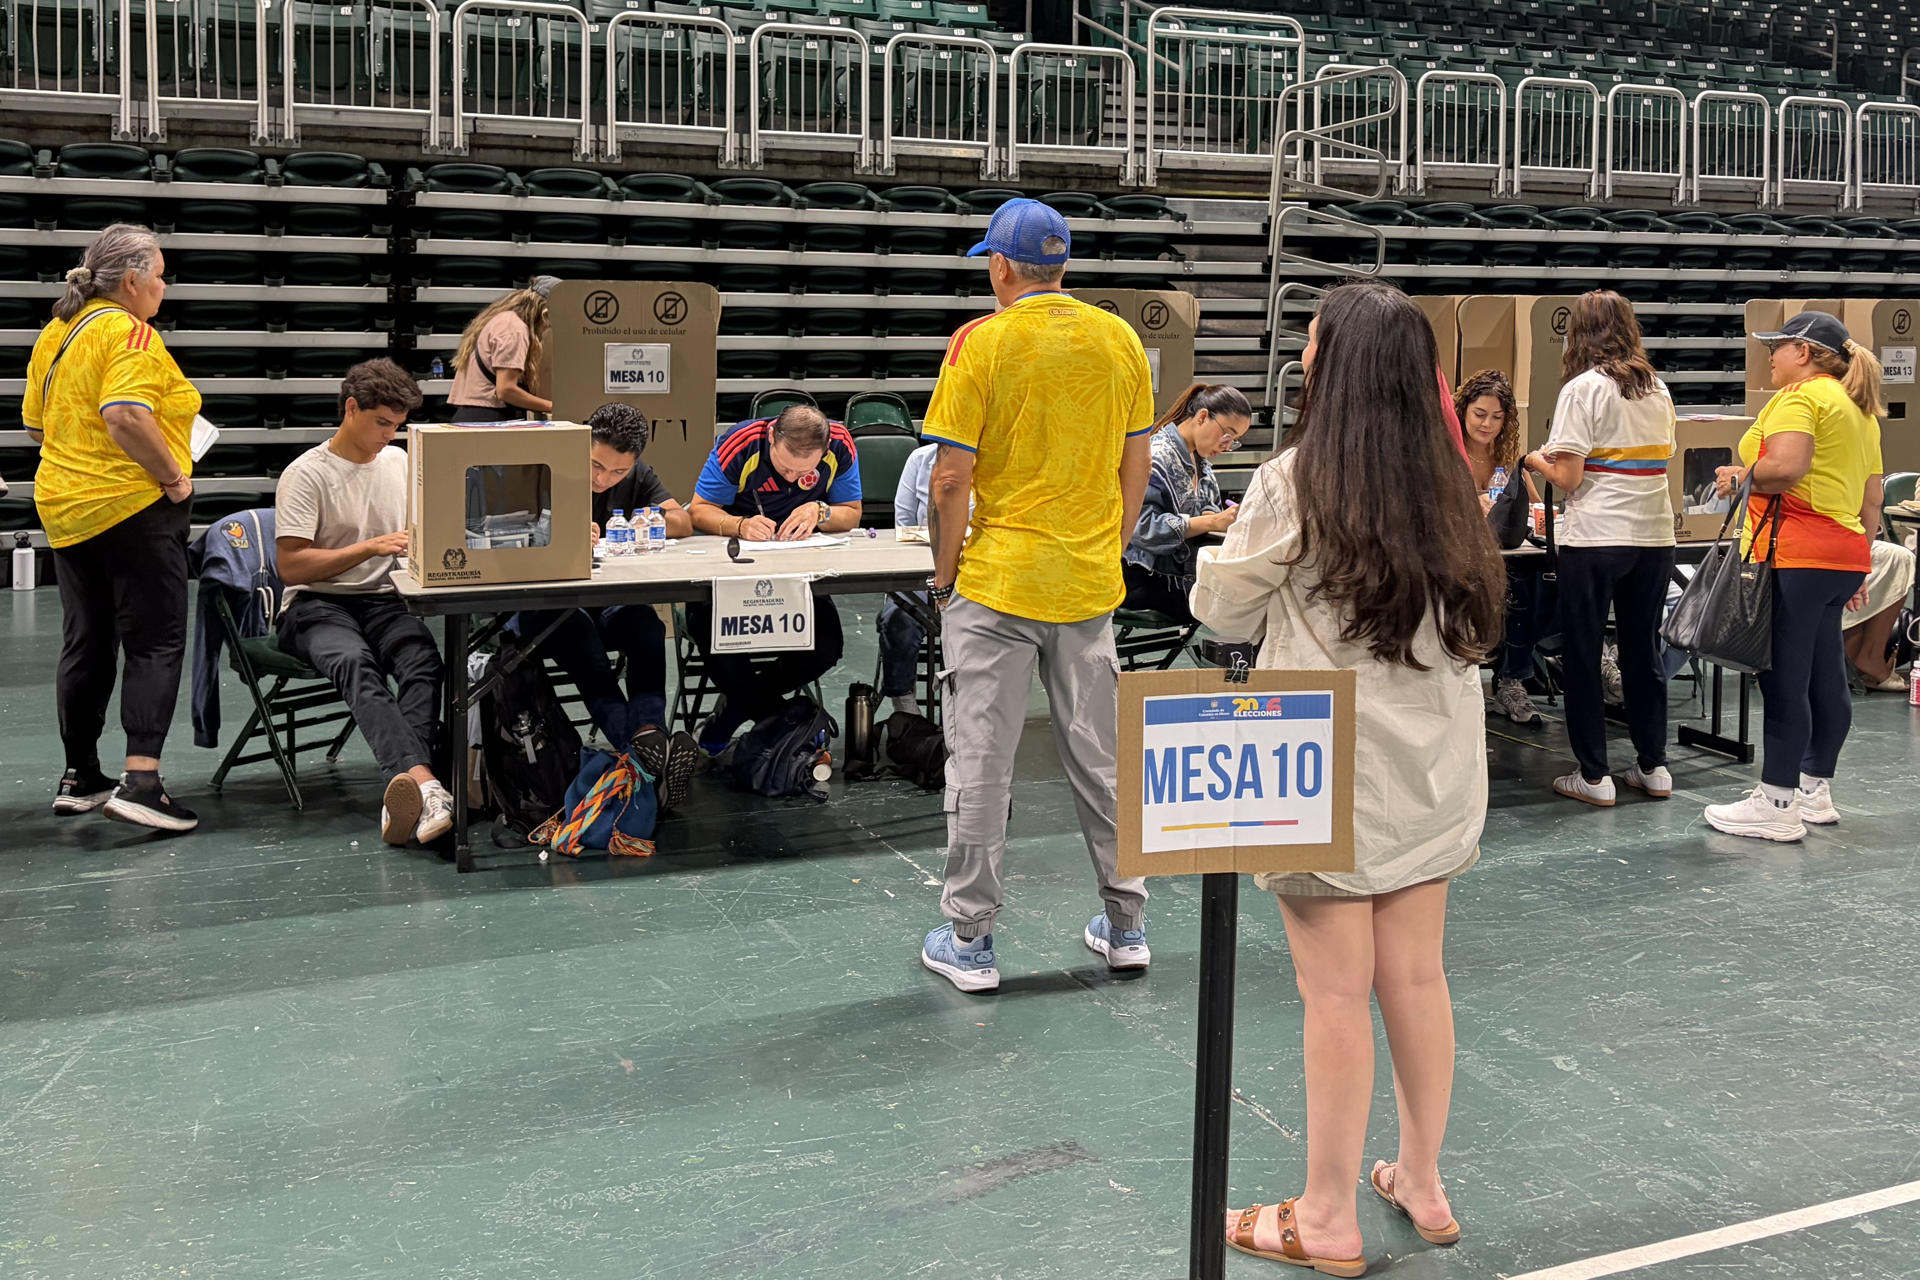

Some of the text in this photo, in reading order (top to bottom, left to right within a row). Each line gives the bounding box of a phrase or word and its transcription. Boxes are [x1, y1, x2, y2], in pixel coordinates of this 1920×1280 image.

[582, 327, 622, 335] Prohibido
[623, 327, 631, 335] el
[610, 370, 665, 383] MESA 10
[1883, 366, 1913, 376] MESA 13
[720, 612, 806, 636] MESA 10
[1143, 741, 1323, 805] MESA 10
